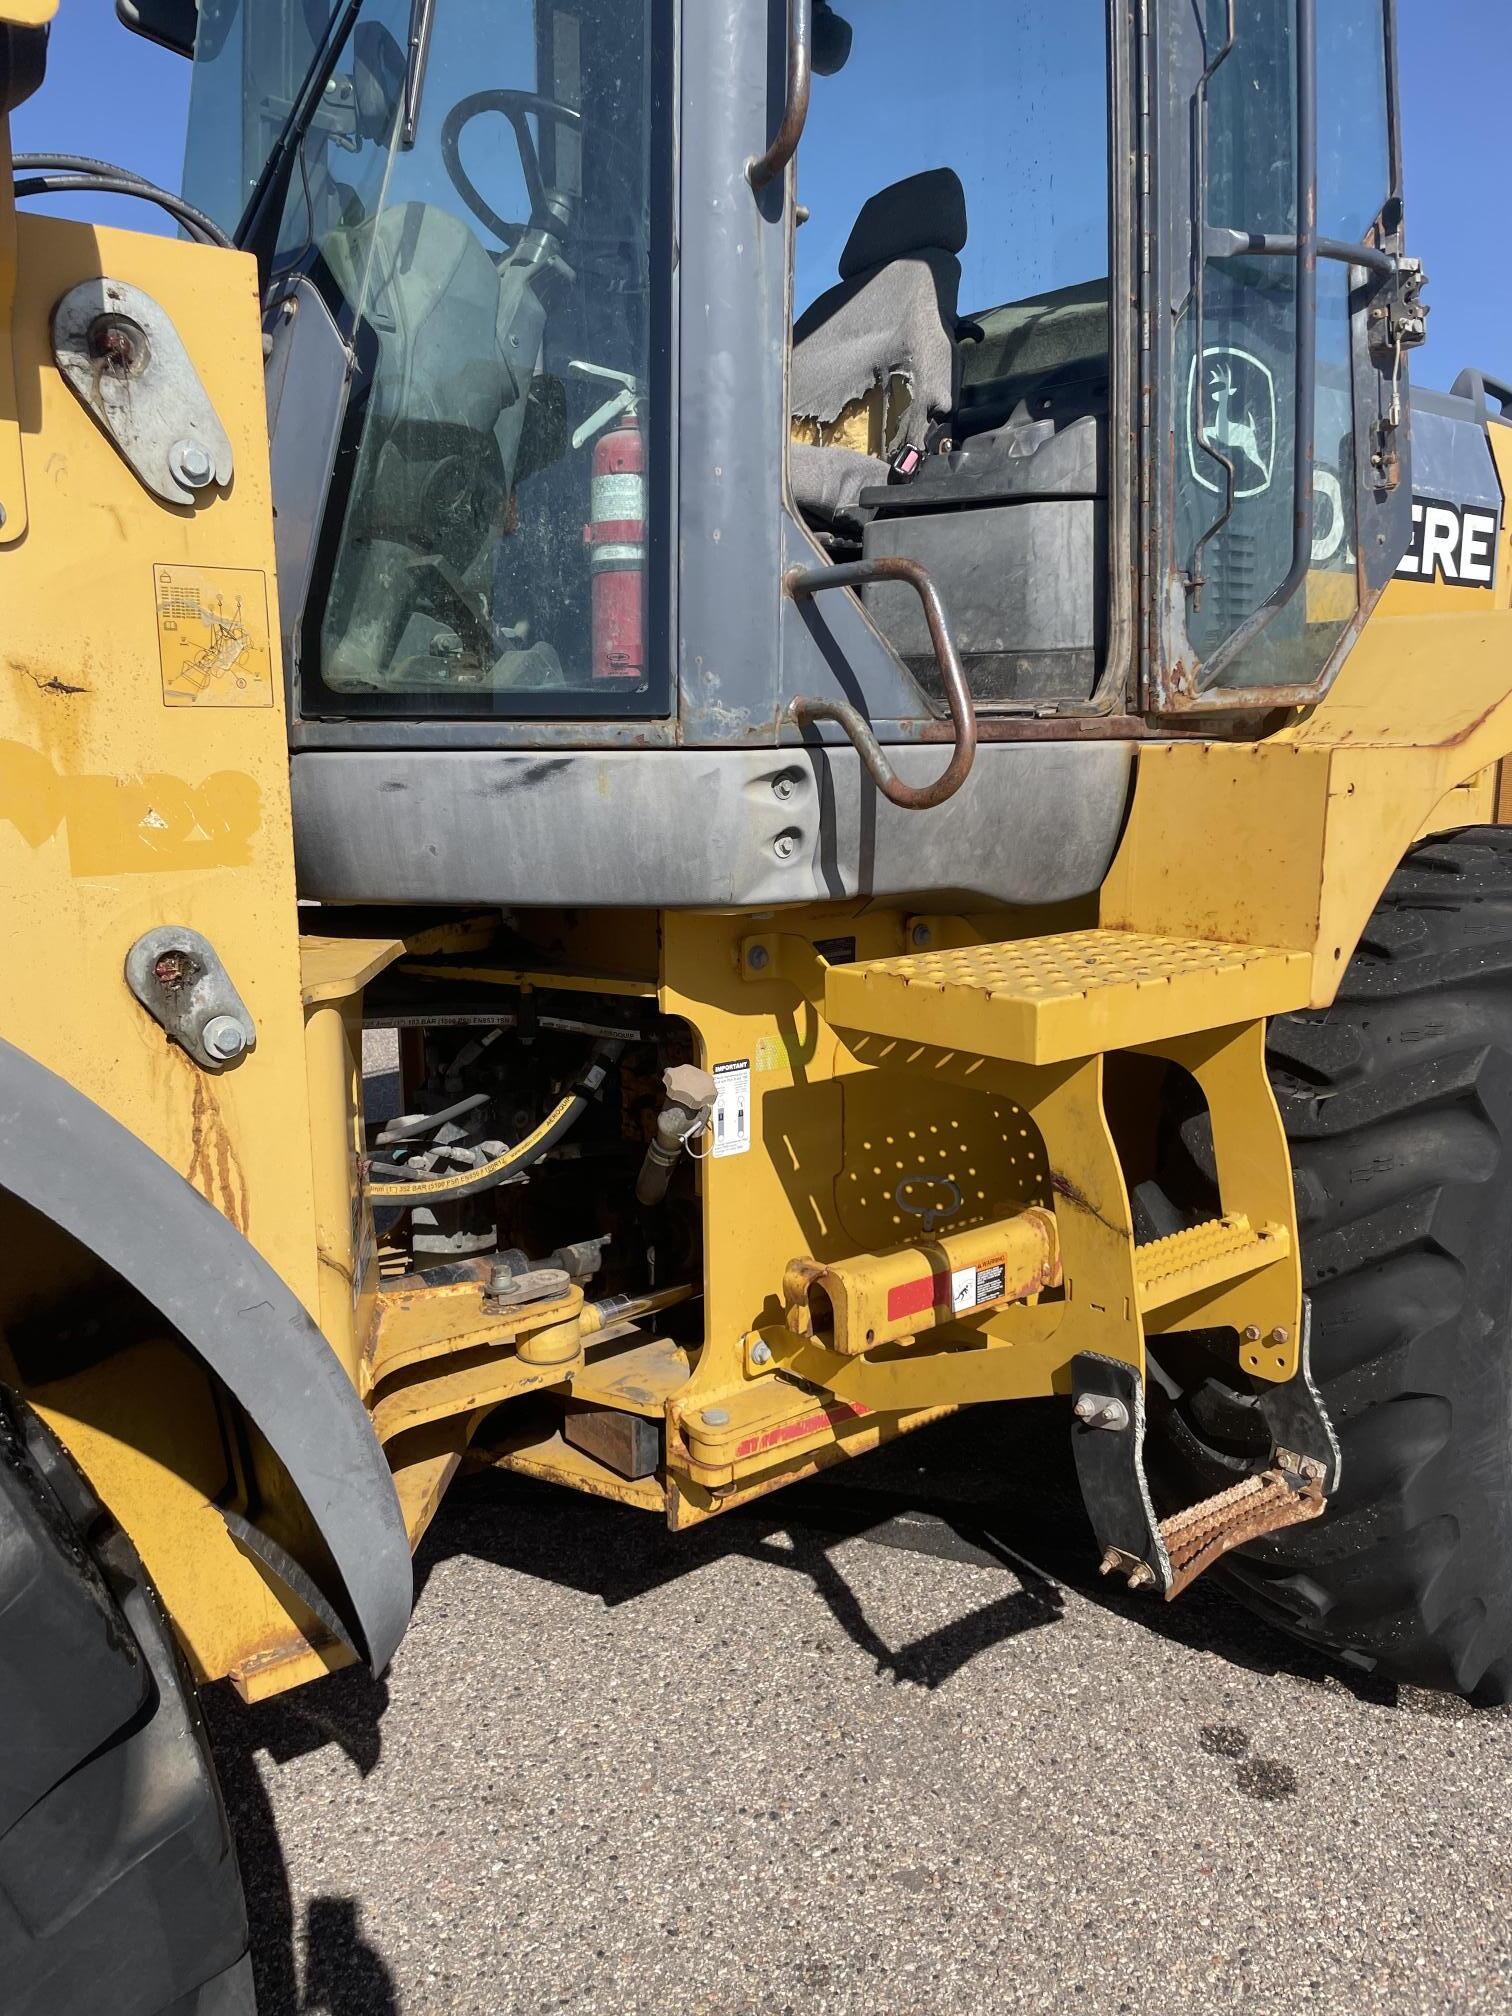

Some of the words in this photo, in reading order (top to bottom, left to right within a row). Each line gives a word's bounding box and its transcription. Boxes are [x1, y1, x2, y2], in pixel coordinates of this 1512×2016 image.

[714, 1061, 748, 1073] IMPORTANT
[546, 1096, 570, 1126] AEROQUIP
[412, 1183, 427, 1192] BAR
